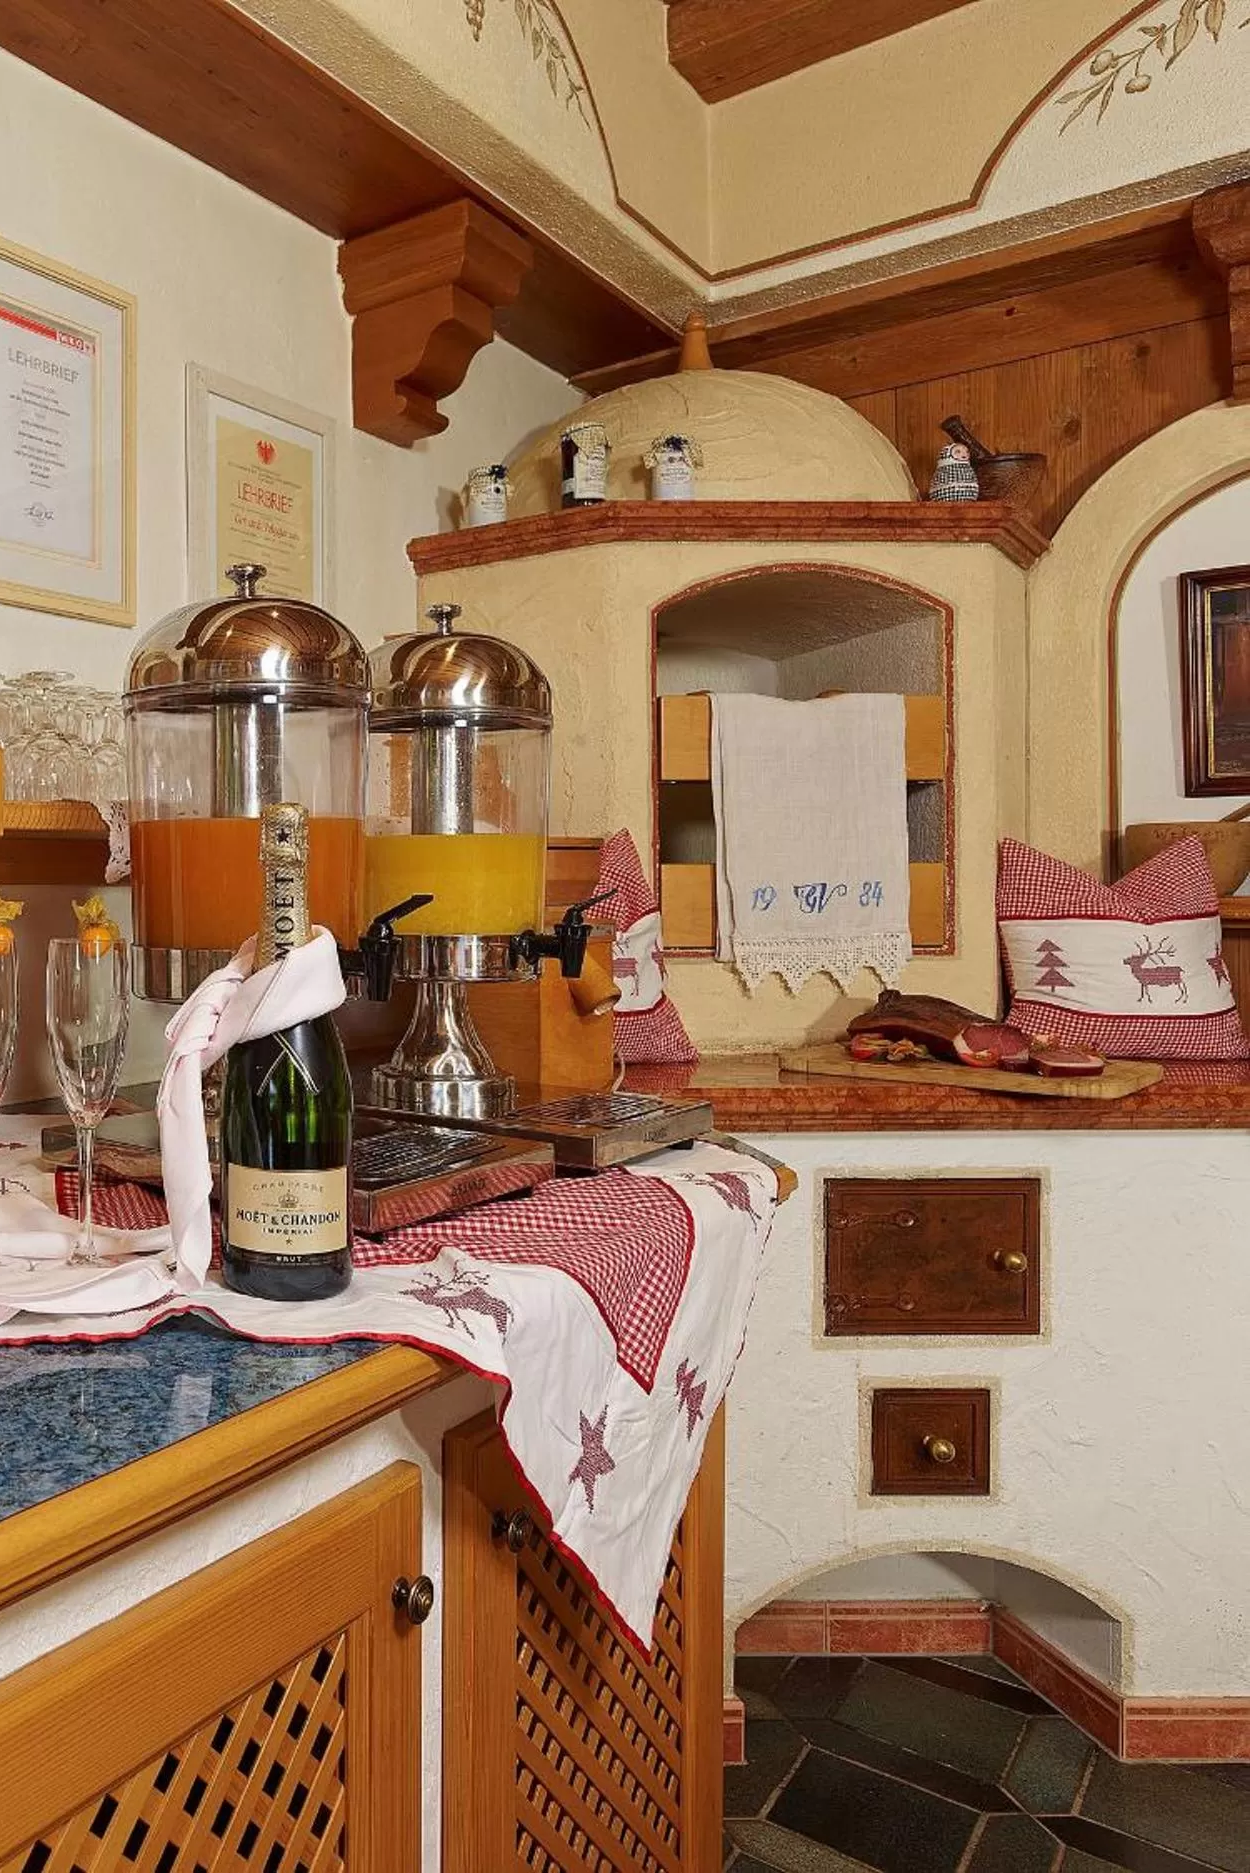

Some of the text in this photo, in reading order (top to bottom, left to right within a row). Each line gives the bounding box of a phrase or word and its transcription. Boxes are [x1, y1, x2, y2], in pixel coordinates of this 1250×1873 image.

[8, 347, 79, 384] LEHRBRIEF
[237, 479, 293, 514] LEHRBRIEF
[752, 885, 777, 911] 19
[859, 880, 884, 908] 84
[273, 871, 295, 962] MOËT
[271, 1214, 279, 1226] &
[281, 1210, 341, 1226] CHANDON
